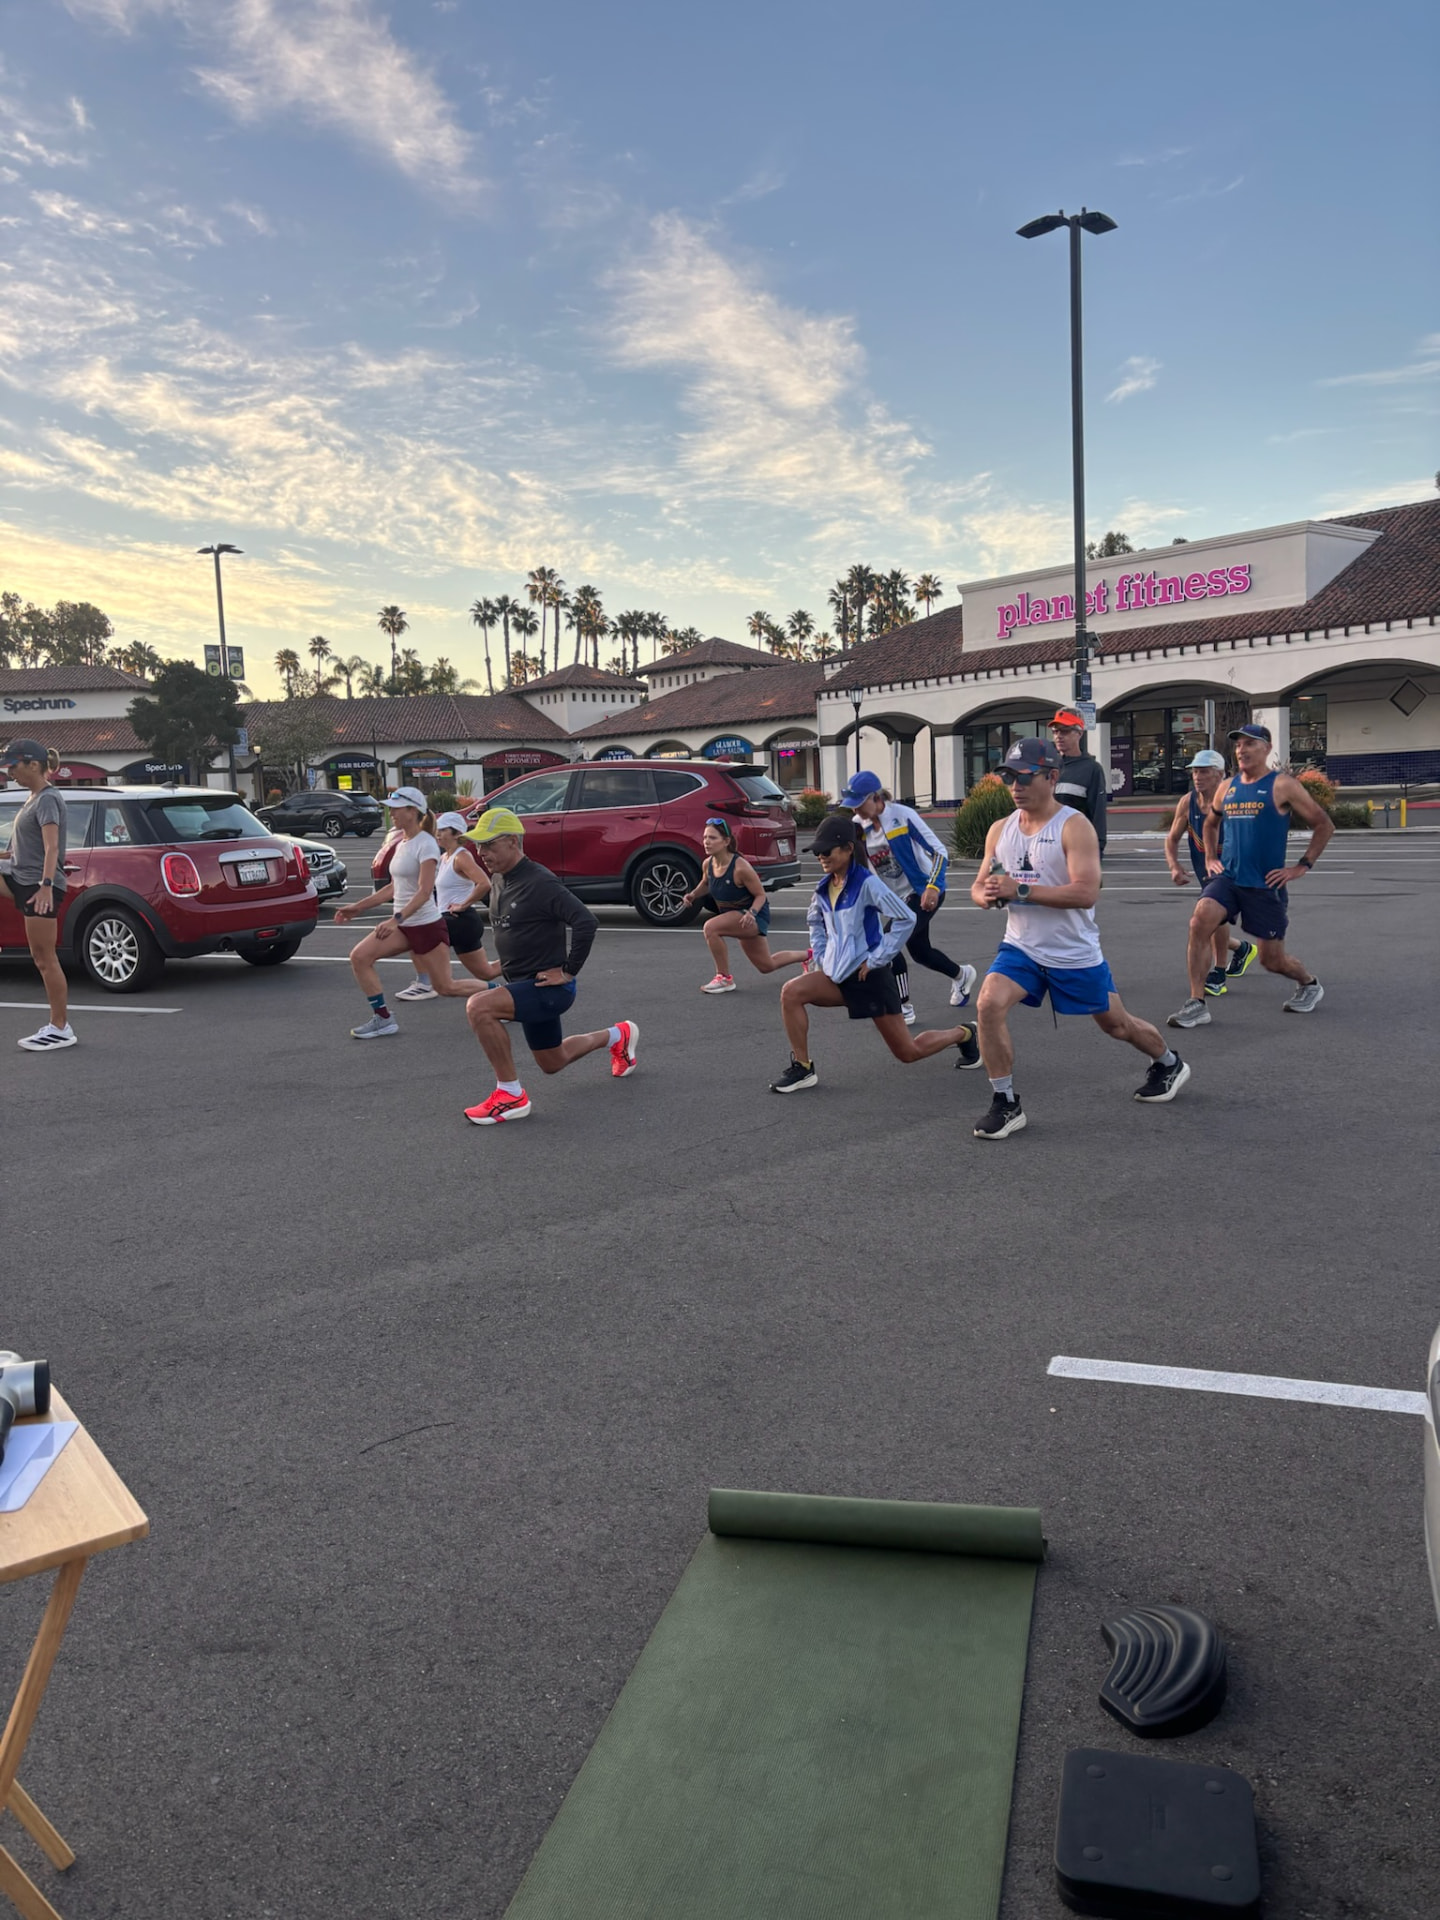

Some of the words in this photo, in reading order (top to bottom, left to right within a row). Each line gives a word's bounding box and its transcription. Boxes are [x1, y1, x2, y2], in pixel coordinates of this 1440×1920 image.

[1114, 563, 1250, 611] fitness
[3, 697, 73, 714] Spectrum
[145, 763, 181, 773] Spectum
[353, 761, 375, 769] BLOCK
[1224, 802, 1238, 811] SAN
[1239, 801, 1265, 809] DIEGO
